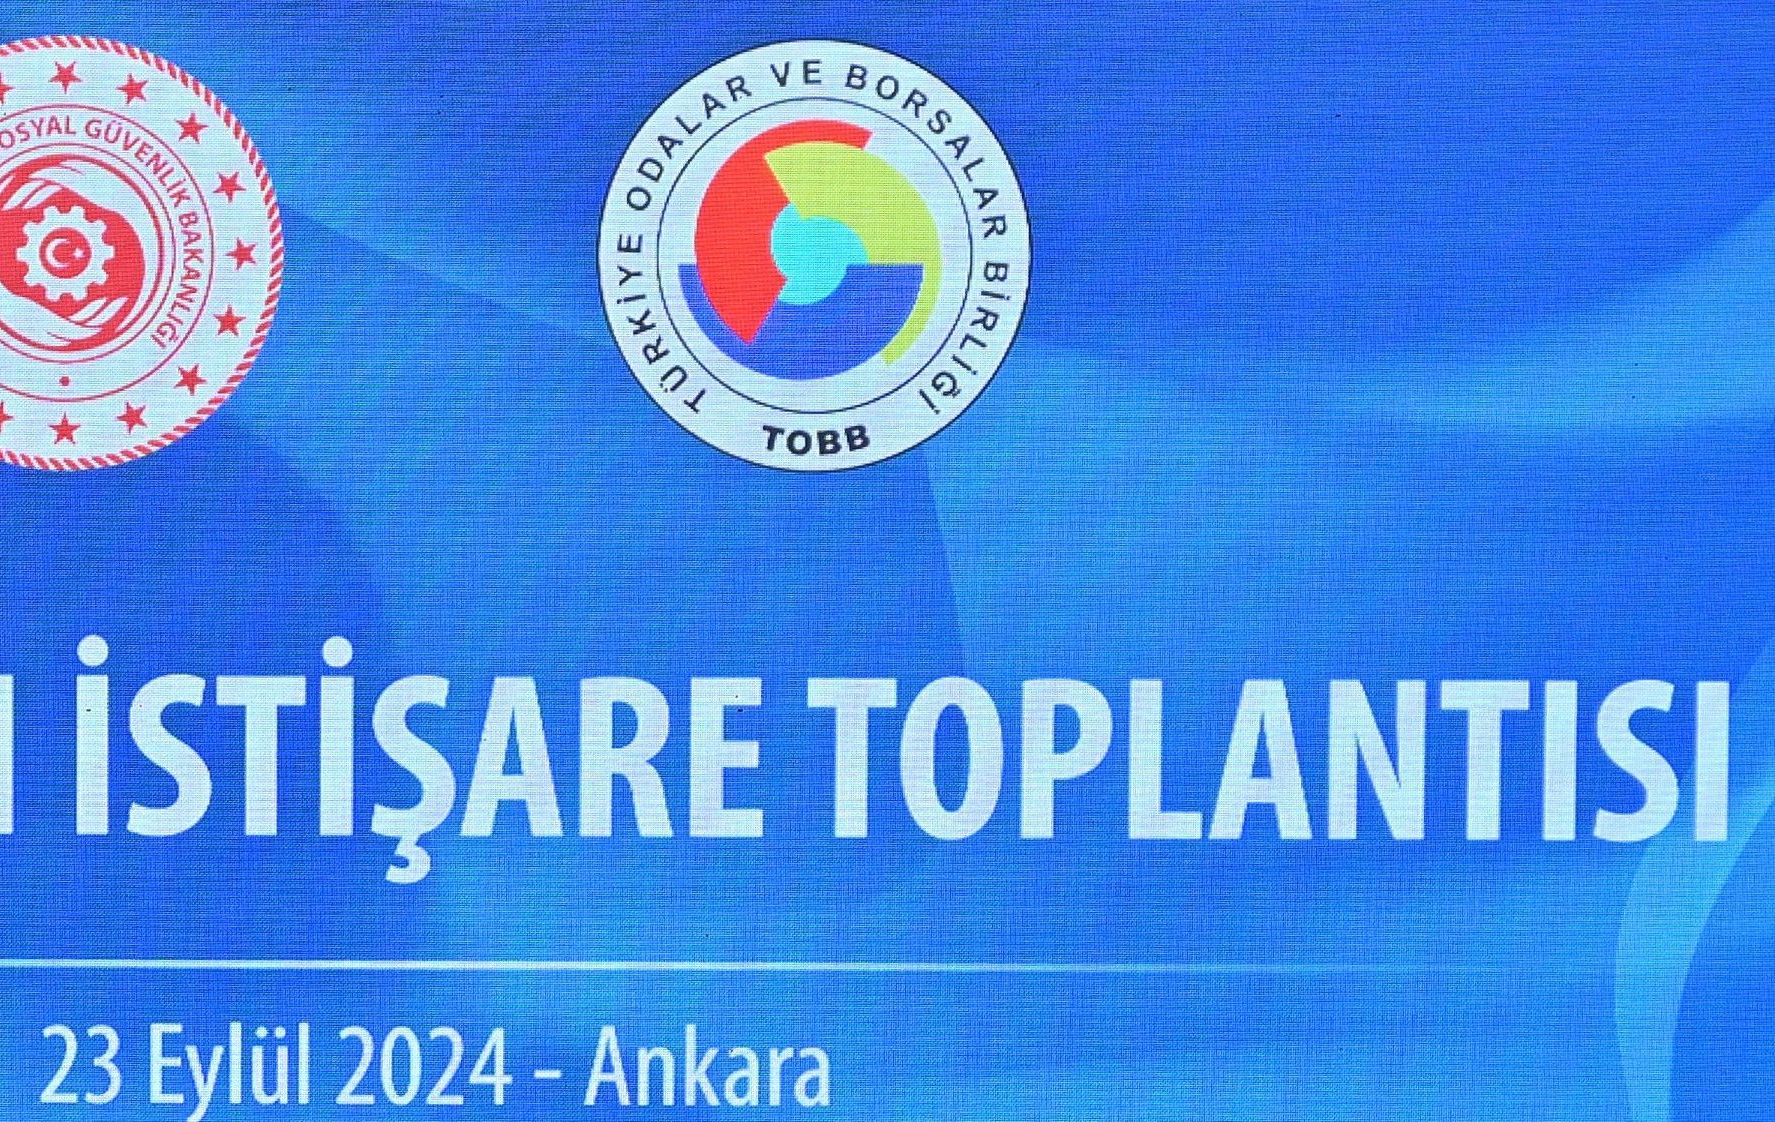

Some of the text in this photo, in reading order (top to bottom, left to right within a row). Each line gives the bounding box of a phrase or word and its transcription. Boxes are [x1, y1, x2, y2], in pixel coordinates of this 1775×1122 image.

[84, 117, 193, 208] GÜVENLİK
[150, 213, 204, 349] BAKANLIĞI
[617, 59, 1011, 415] TÜRKİYE ODALAR VE BORSALAR BİRLİĞİ
[762, 424, 871, 456] TOBB
[75, 634, 765, 885] İSTİŞARE
[806, 675, 1732, 843] TOPLANTISI
[39, 1024, 123, 1105] 23
[335, 1025, 513, 1106] 2024
[583, 1024, 831, 1108] Ankara
